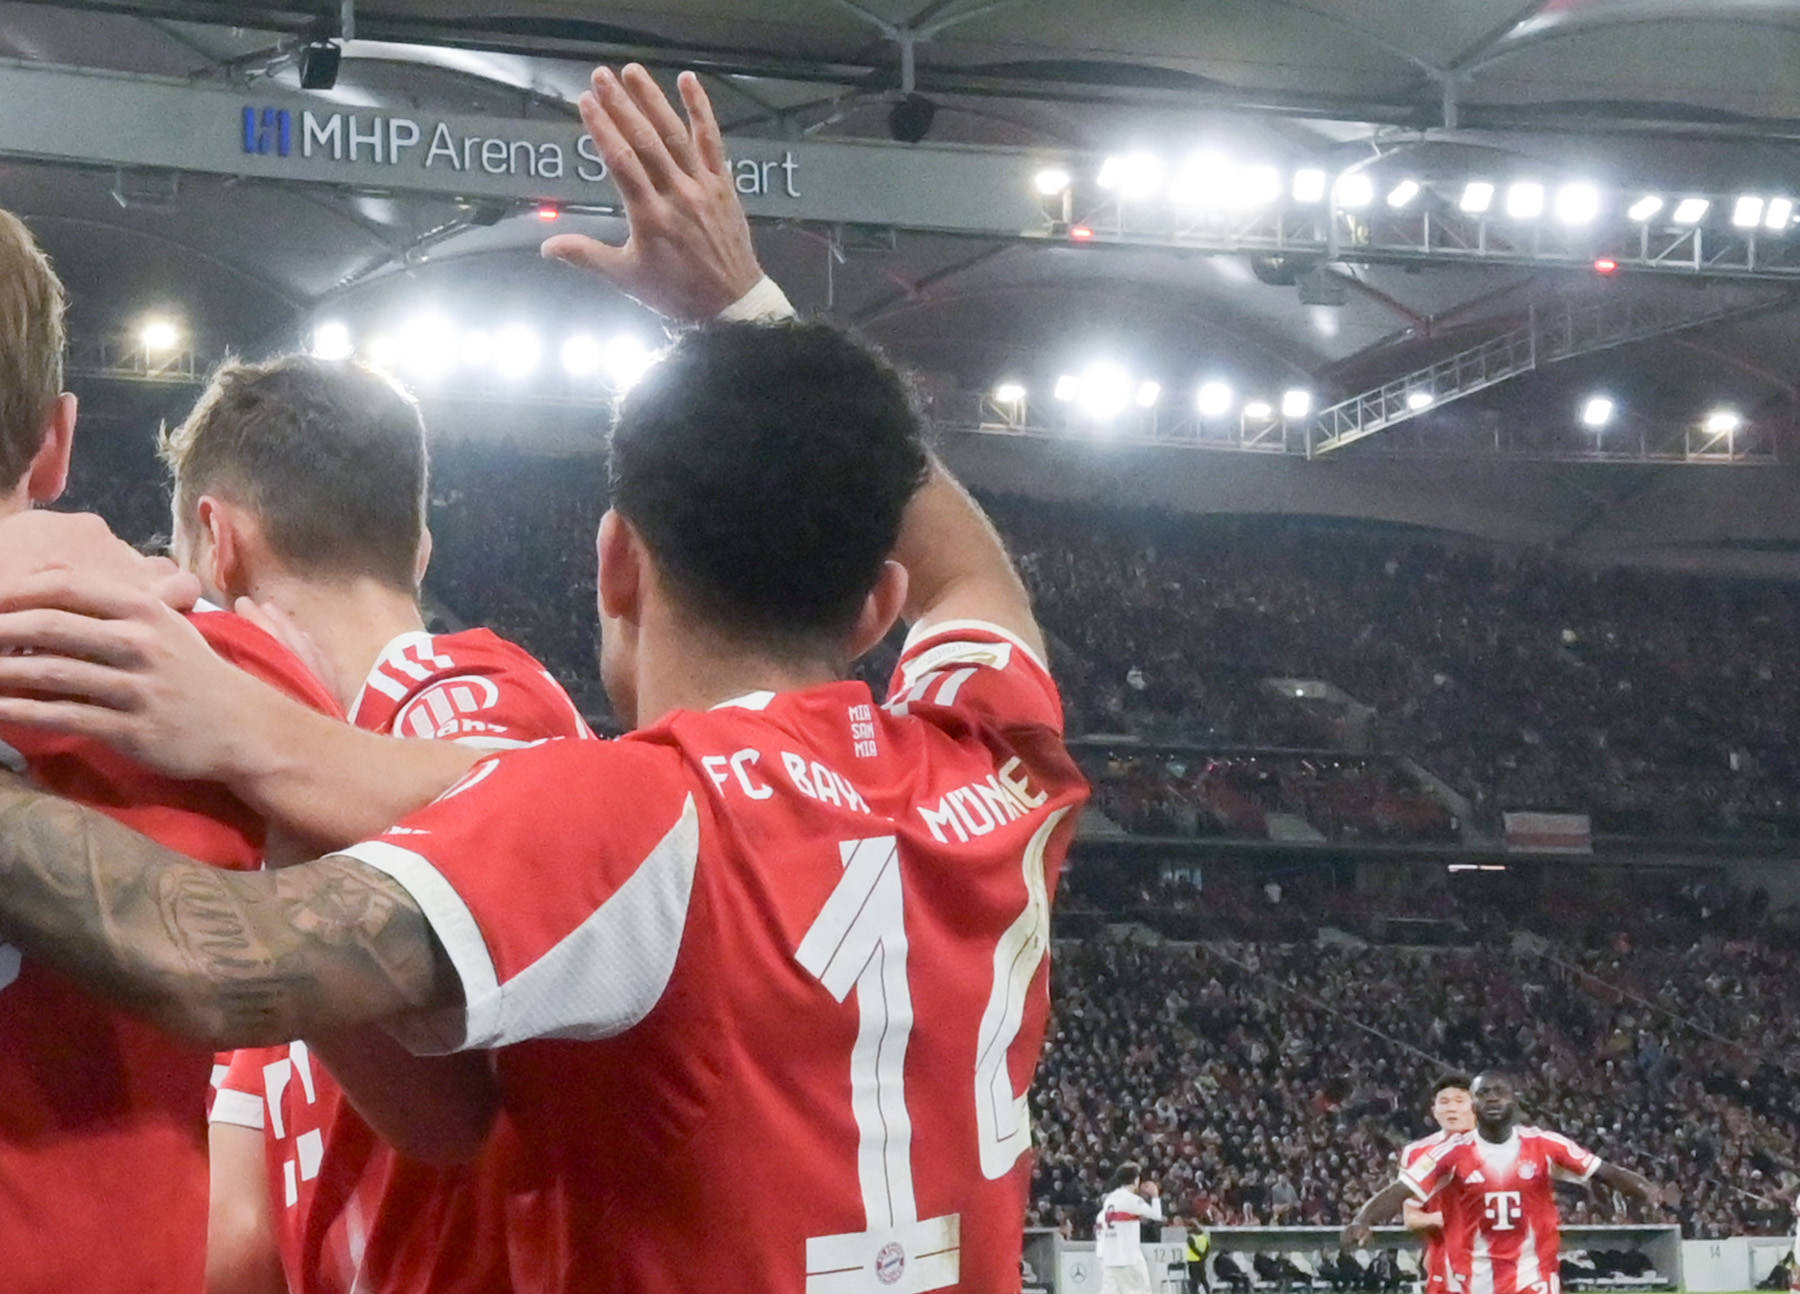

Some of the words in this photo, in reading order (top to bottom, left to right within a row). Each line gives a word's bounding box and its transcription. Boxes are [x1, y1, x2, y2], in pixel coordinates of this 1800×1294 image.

[303, 111, 420, 164] MHP
[425, 122, 563, 178] Arena
[702, 748, 773, 800] FC
[781, 751, 871, 814] BAY
